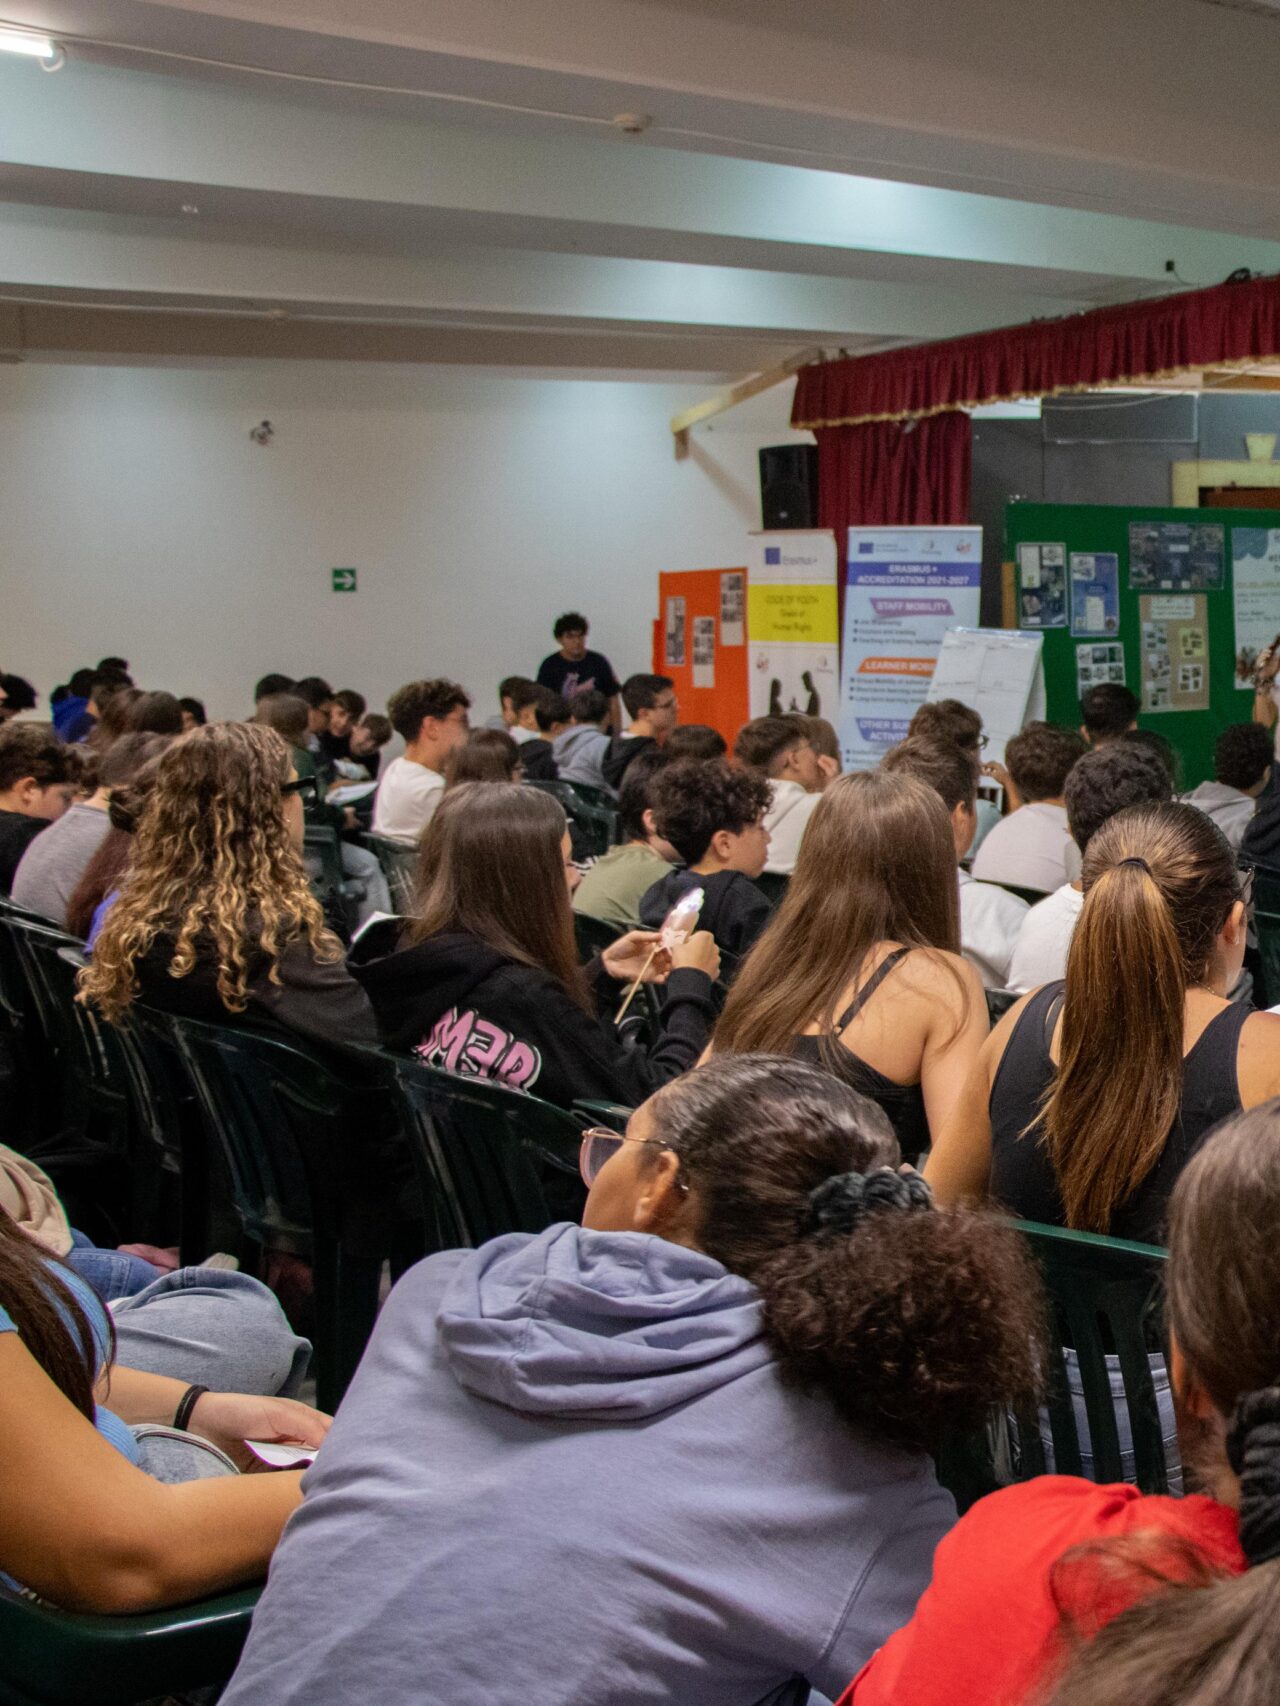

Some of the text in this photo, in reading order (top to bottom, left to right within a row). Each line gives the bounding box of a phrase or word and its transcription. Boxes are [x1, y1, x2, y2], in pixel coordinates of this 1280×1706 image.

[888, 564, 931, 574] ERASMUS
[876, 601, 948, 611] STAFF MOBILITY
